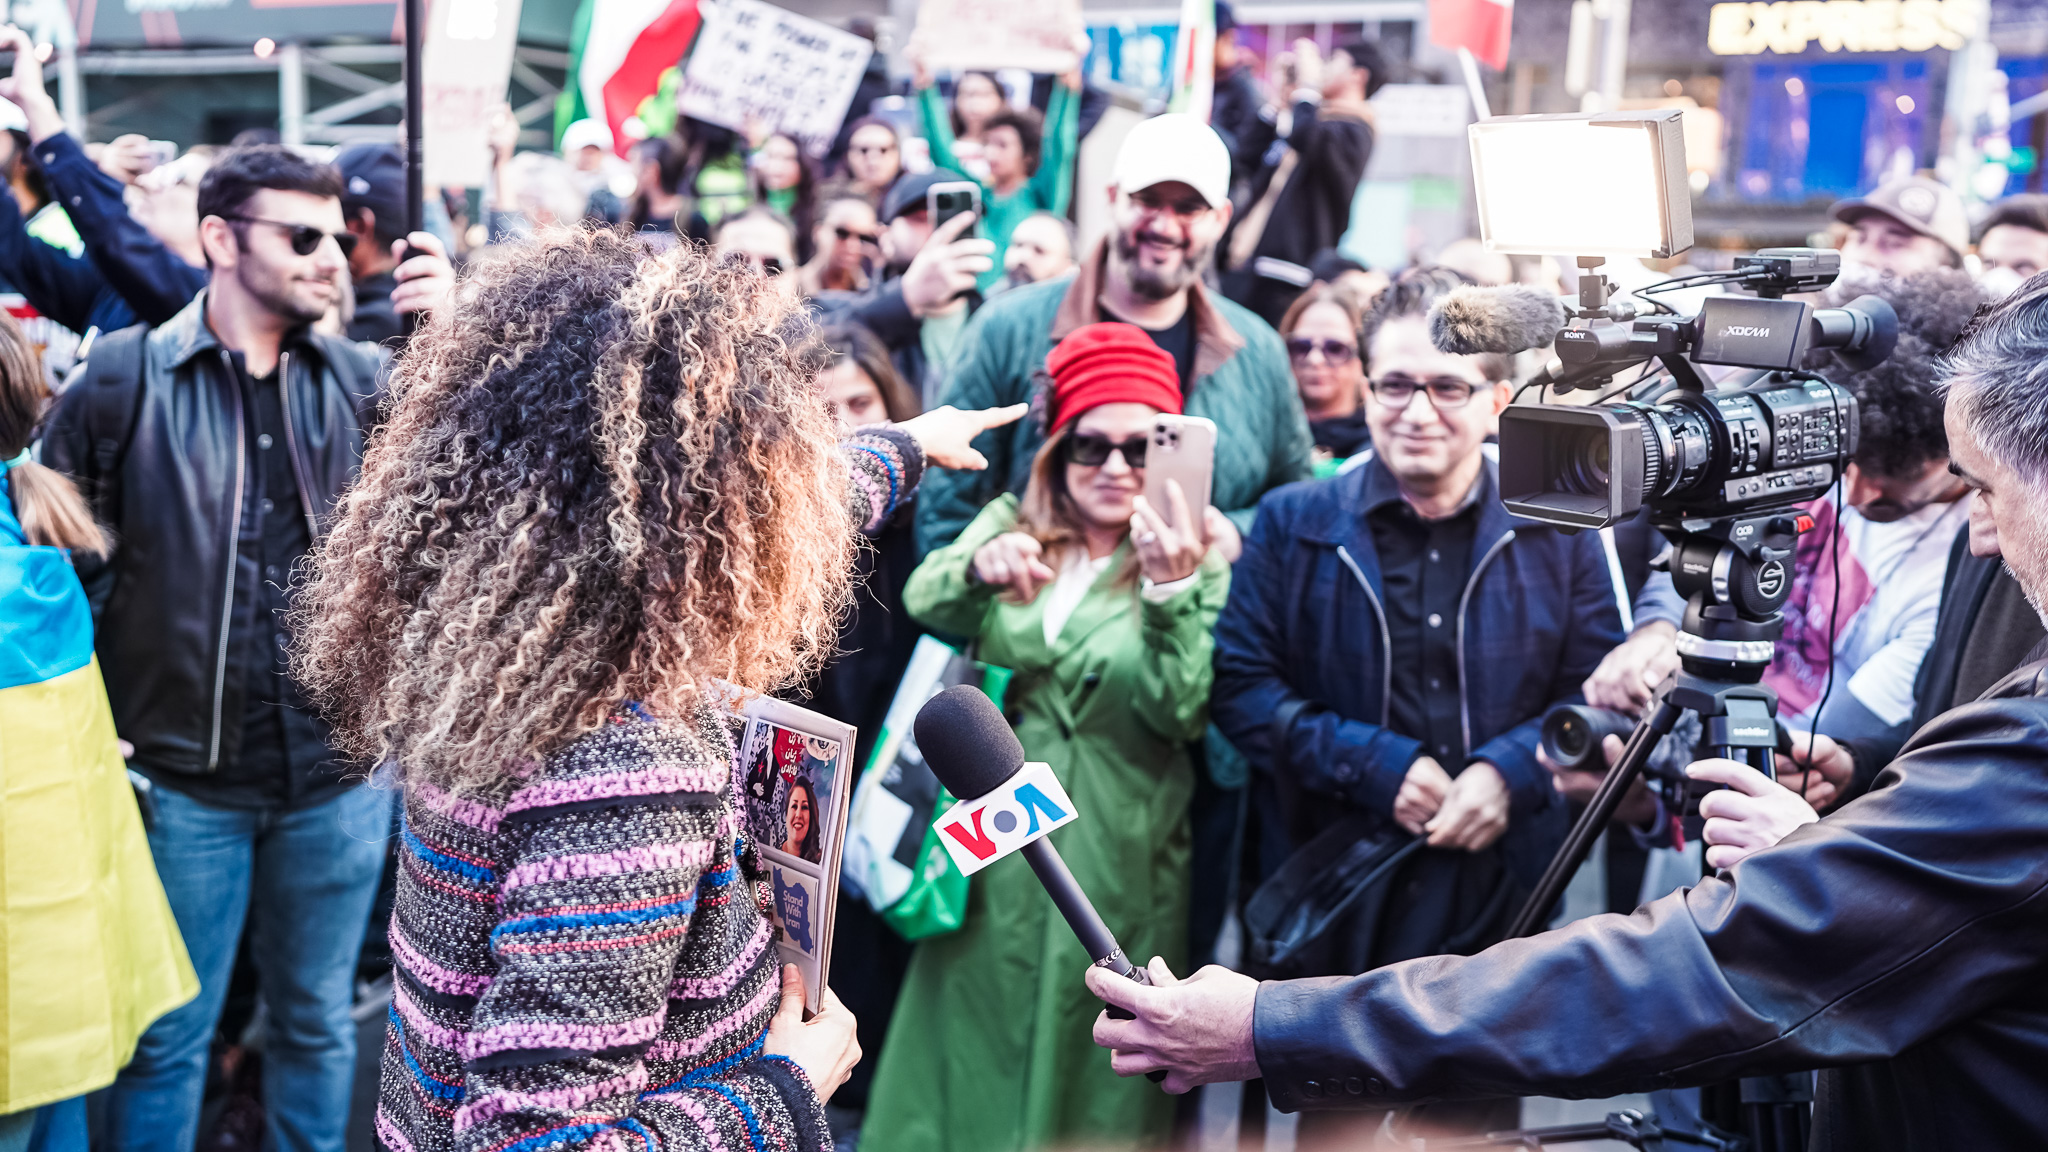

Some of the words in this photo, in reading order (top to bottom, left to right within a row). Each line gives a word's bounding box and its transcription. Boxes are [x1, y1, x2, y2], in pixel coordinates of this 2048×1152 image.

[1707, 0, 1979, 55] EXPRESS
[1563, 331, 1586, 340] SONY
[1726, 325, 1770, 338] XDCAM
[943, 782, 1068, 861] VOA
[783, 890, 804, 908] Stand
[784, 902, 802, 919] With
[785, 913, 801, 930] Iran
